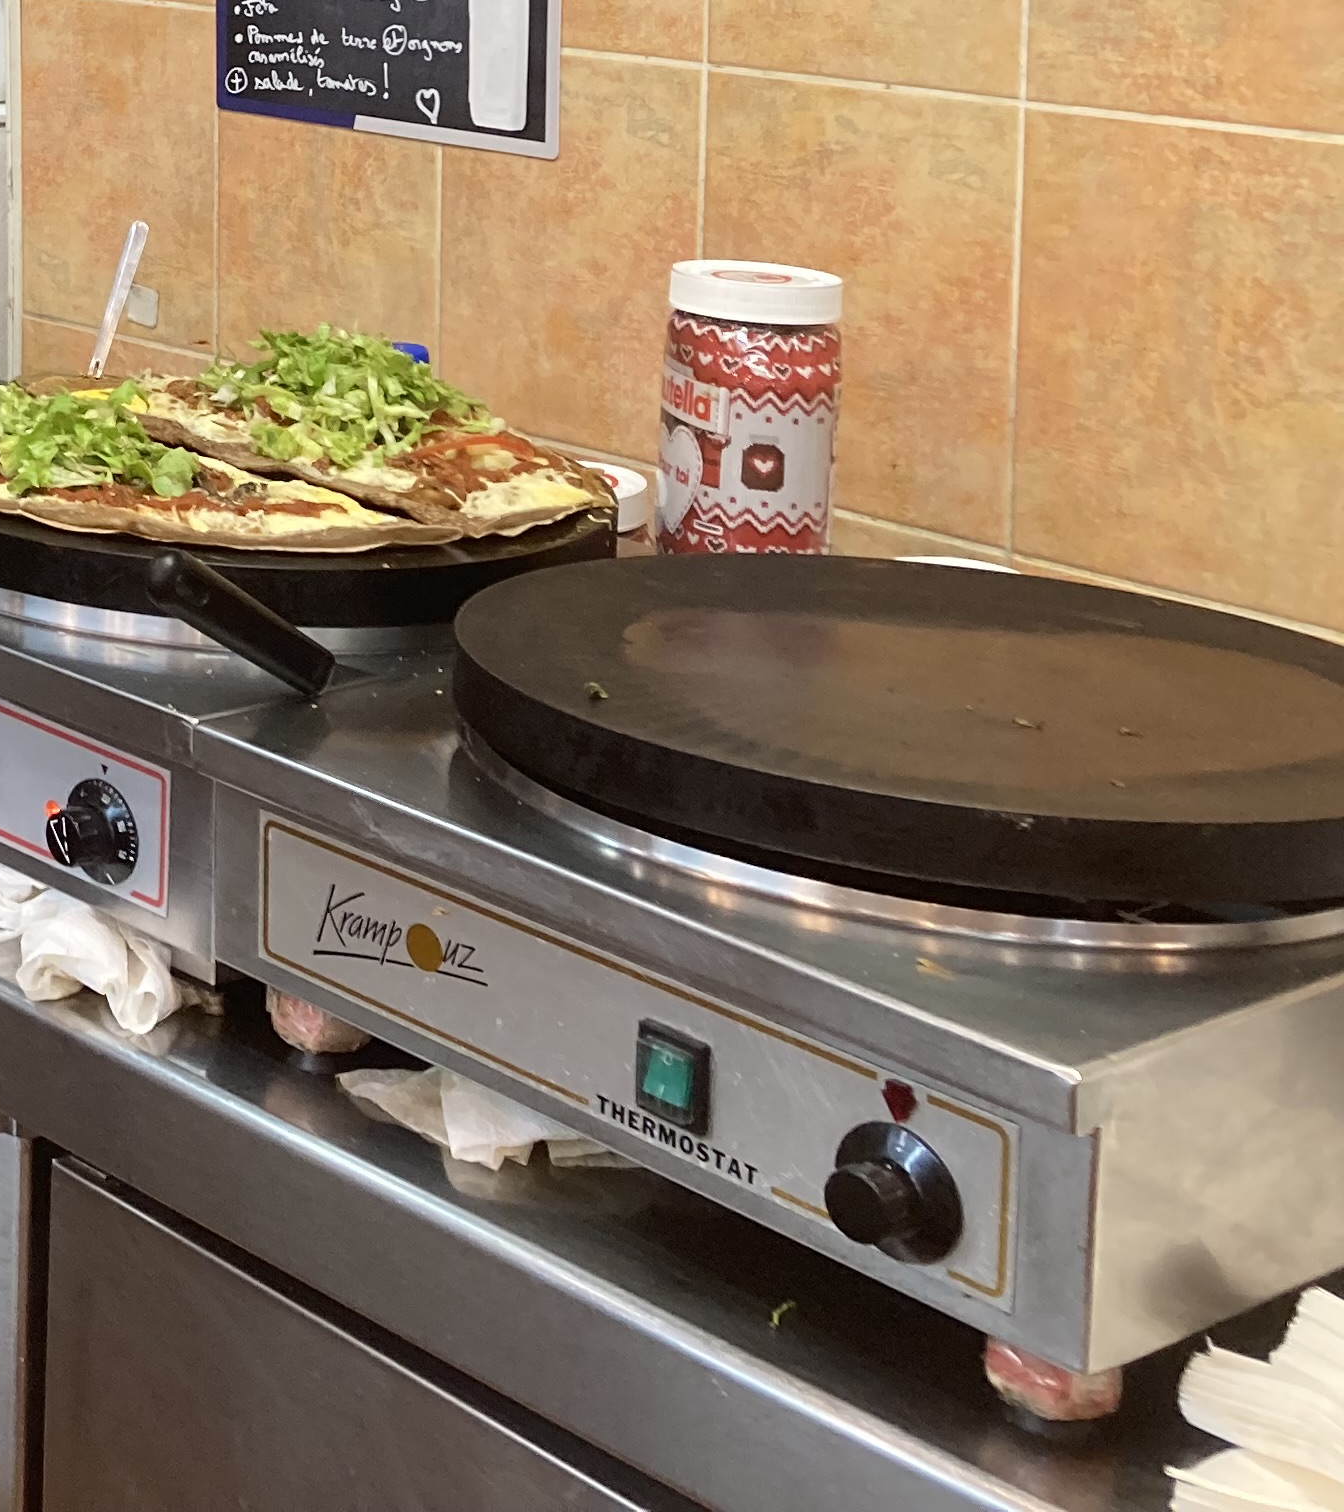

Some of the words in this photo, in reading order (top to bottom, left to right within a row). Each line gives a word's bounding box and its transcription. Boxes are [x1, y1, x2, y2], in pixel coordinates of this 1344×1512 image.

[247, 24, 303, 45] Pommes
[311, 28, 330, 46] de
[341, 27, 377, 50] terre
[317, 883, 485, 974] Krampouz
[596, 1093, 760, 1186] THERMOSTAT
